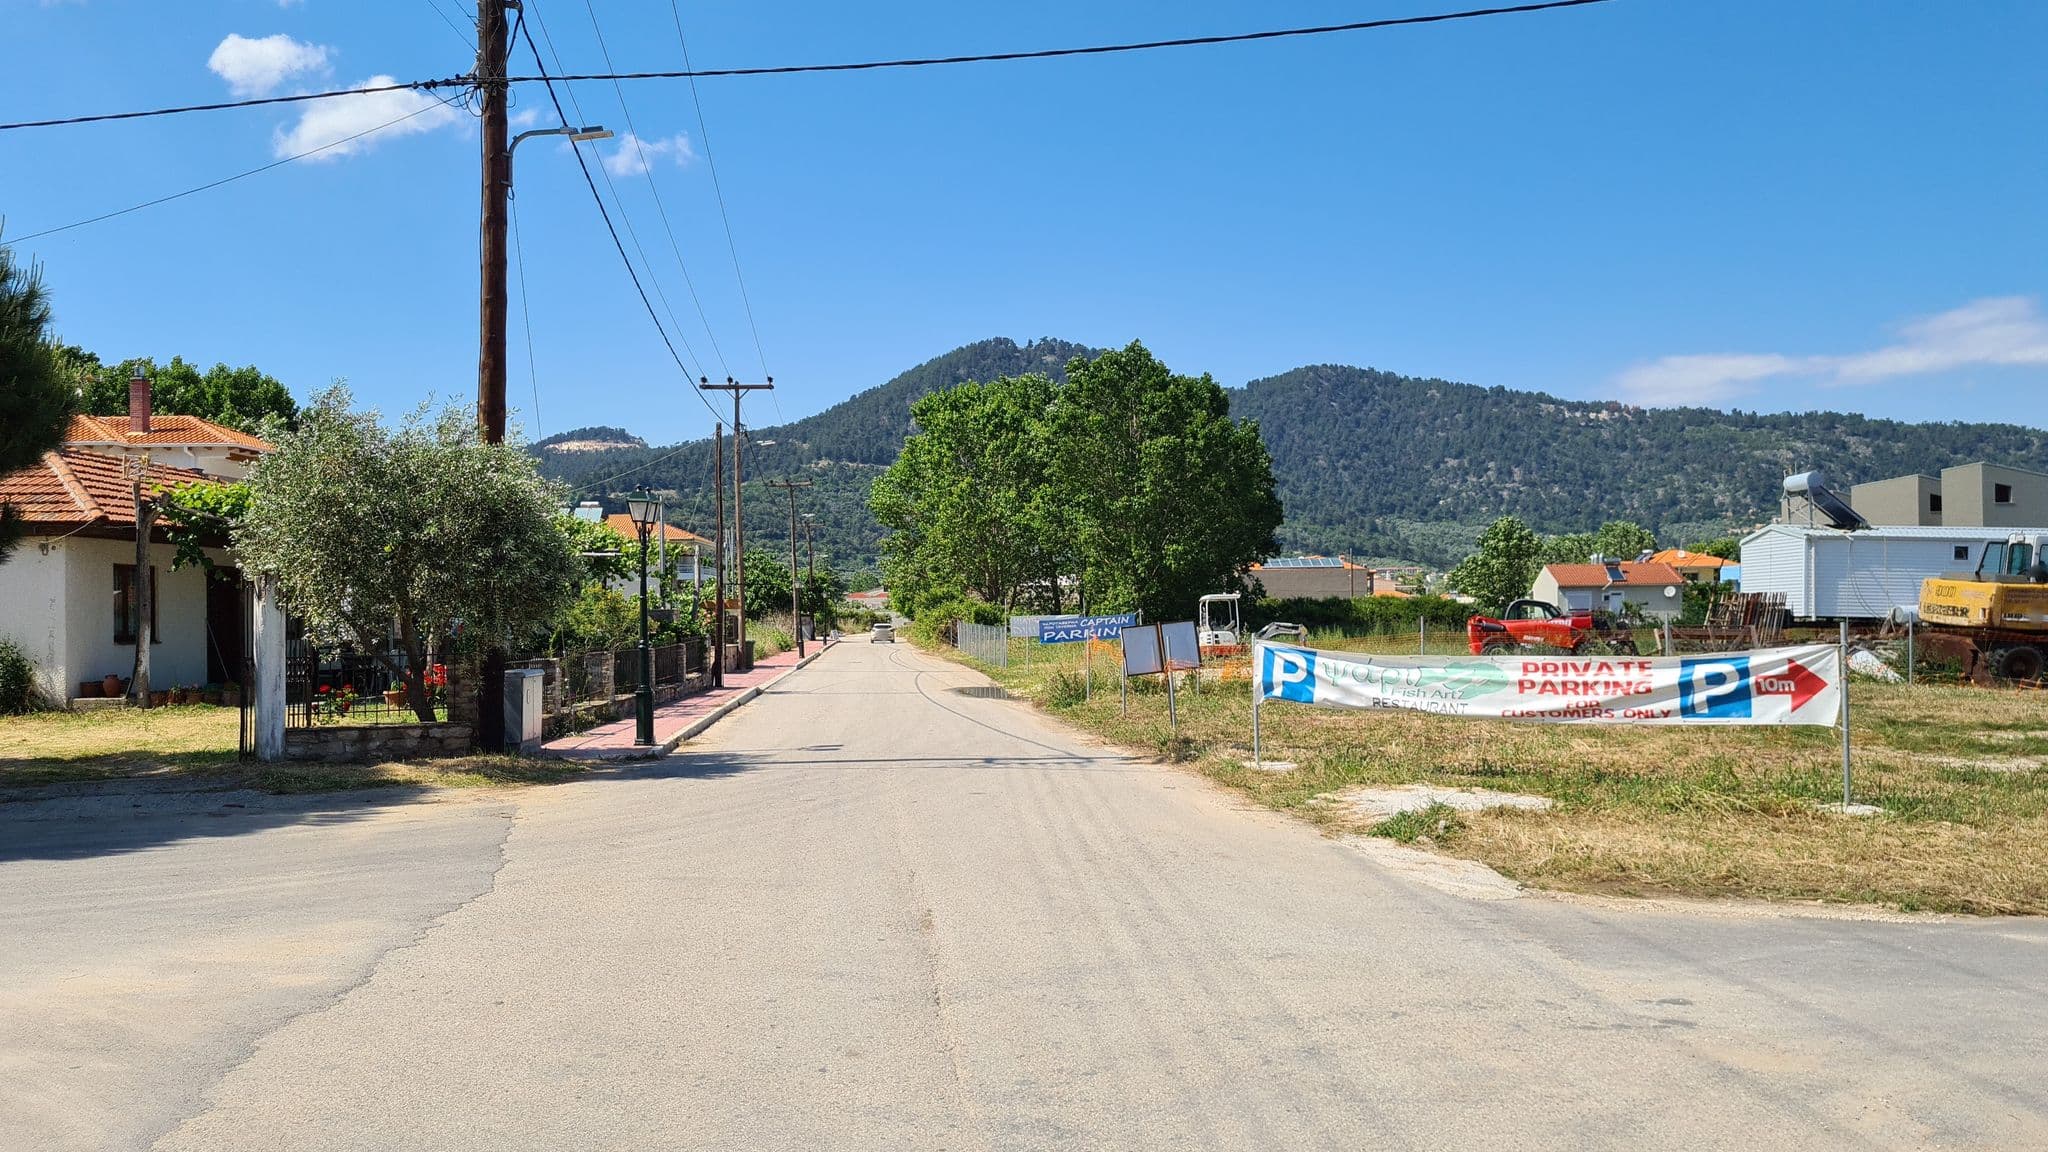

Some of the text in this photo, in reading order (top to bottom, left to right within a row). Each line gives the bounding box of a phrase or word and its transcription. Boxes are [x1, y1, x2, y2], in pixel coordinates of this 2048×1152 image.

[1080, 616, 1129, 627] CAPTAIN
[1044, 626, 1122, 641] PARKIN
[1272, 650, 1307, 697] P
[1522, 661, 1654, 677] PRIVATE
[1517, 679, 1652, 696] PARKING
[1687, 663, 1739, 714] P
[1757, 677, 1796, 692] 10m
[1391, 688, 1426, 698] Fish
[1372, 697, 1469, 714] RESTAURANT
[1501, 708, 1672, 719] CUSTOMERS ONLY
